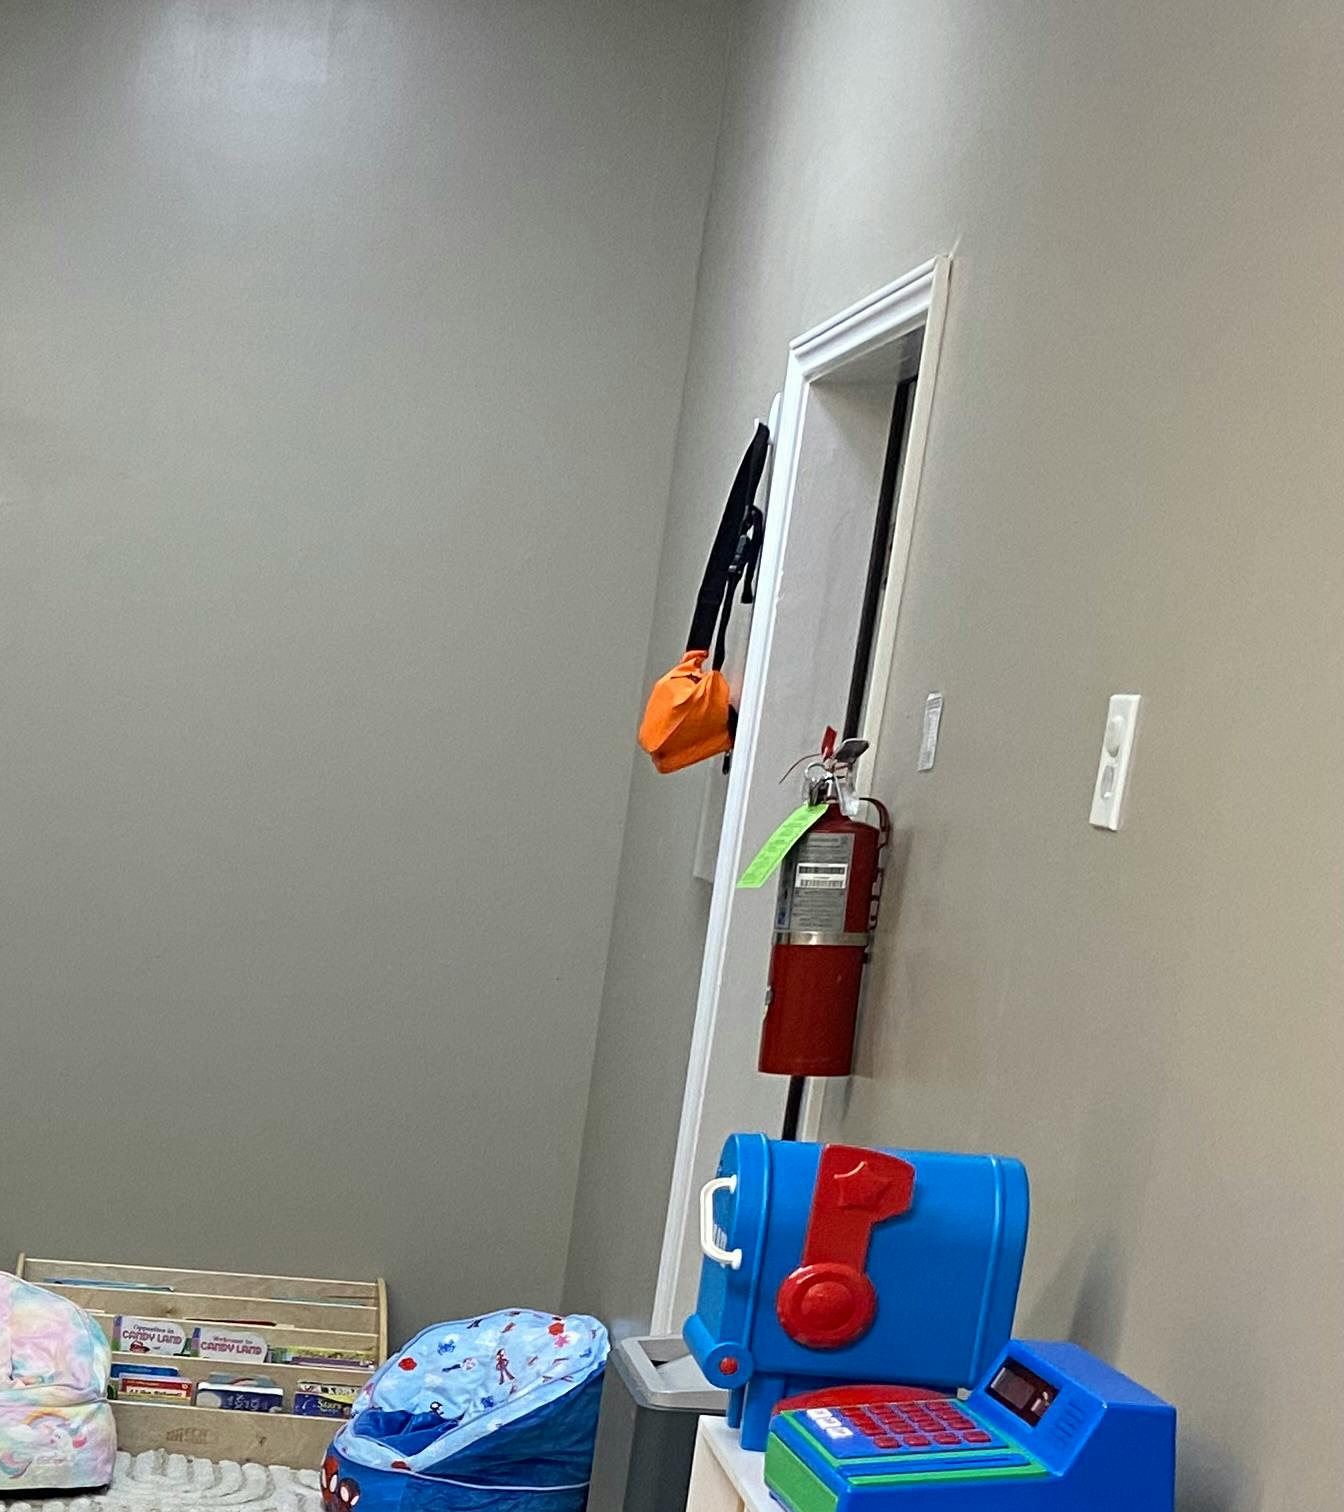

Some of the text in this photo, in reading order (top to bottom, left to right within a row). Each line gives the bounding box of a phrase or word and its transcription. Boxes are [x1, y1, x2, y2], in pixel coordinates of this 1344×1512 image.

[122, 1330, 182, 1345] CANDY LAND
[200, 1341, 262, 1356] CANDY LAND
